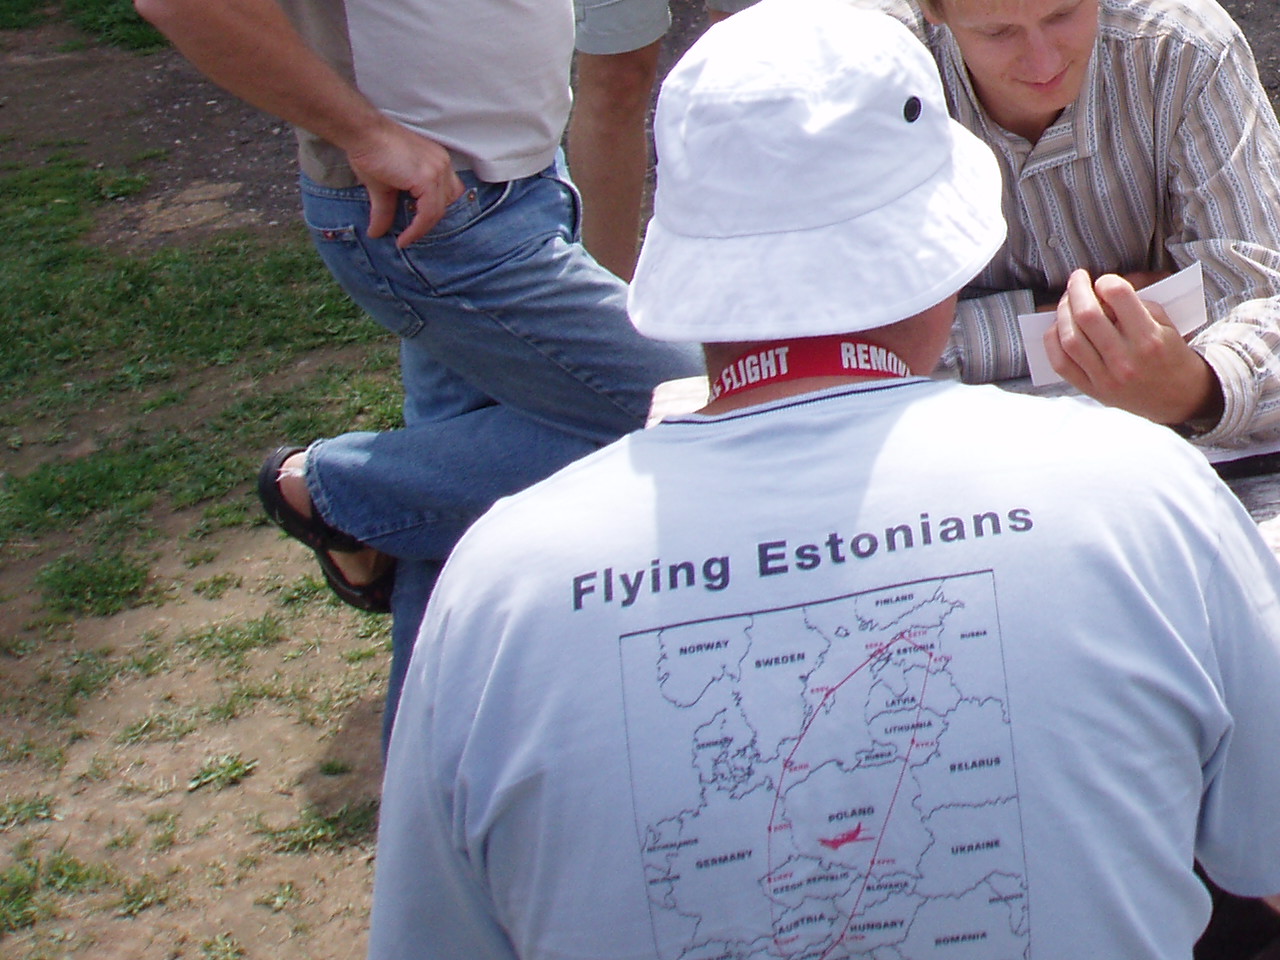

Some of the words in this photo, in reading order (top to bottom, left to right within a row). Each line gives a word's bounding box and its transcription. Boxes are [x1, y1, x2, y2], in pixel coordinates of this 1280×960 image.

[722, 346, 789, 393] FLIGHT
[572, 554, 731, 611] Flying
[757, 507, 1034, 578] Estonians
[875, 593, 915, 607] FINLAND
[679, 640, 730, 656] NORWAY
[896, 643, 935, 656] ESTONIA
[755, 652, 806, 668] SWEDEN
[885, 696, 916, 708] LATVIA
[884, 720, 933, 735] LITHUANIA
[949, 757, 1001, 773] BELARUS
[828, 806, 875, 823] POLAND
[951, 839, 1001, 855] UKRAINE
[695, 850, 752, 870] GERMANY
[866, 880, 909, 892] SLOVAKIA
[778, 913, 826, 935] AUSTRIA
[850, 919, 905, 933] HUNGARY
[934, 931, 988, 947] ROMANIA
